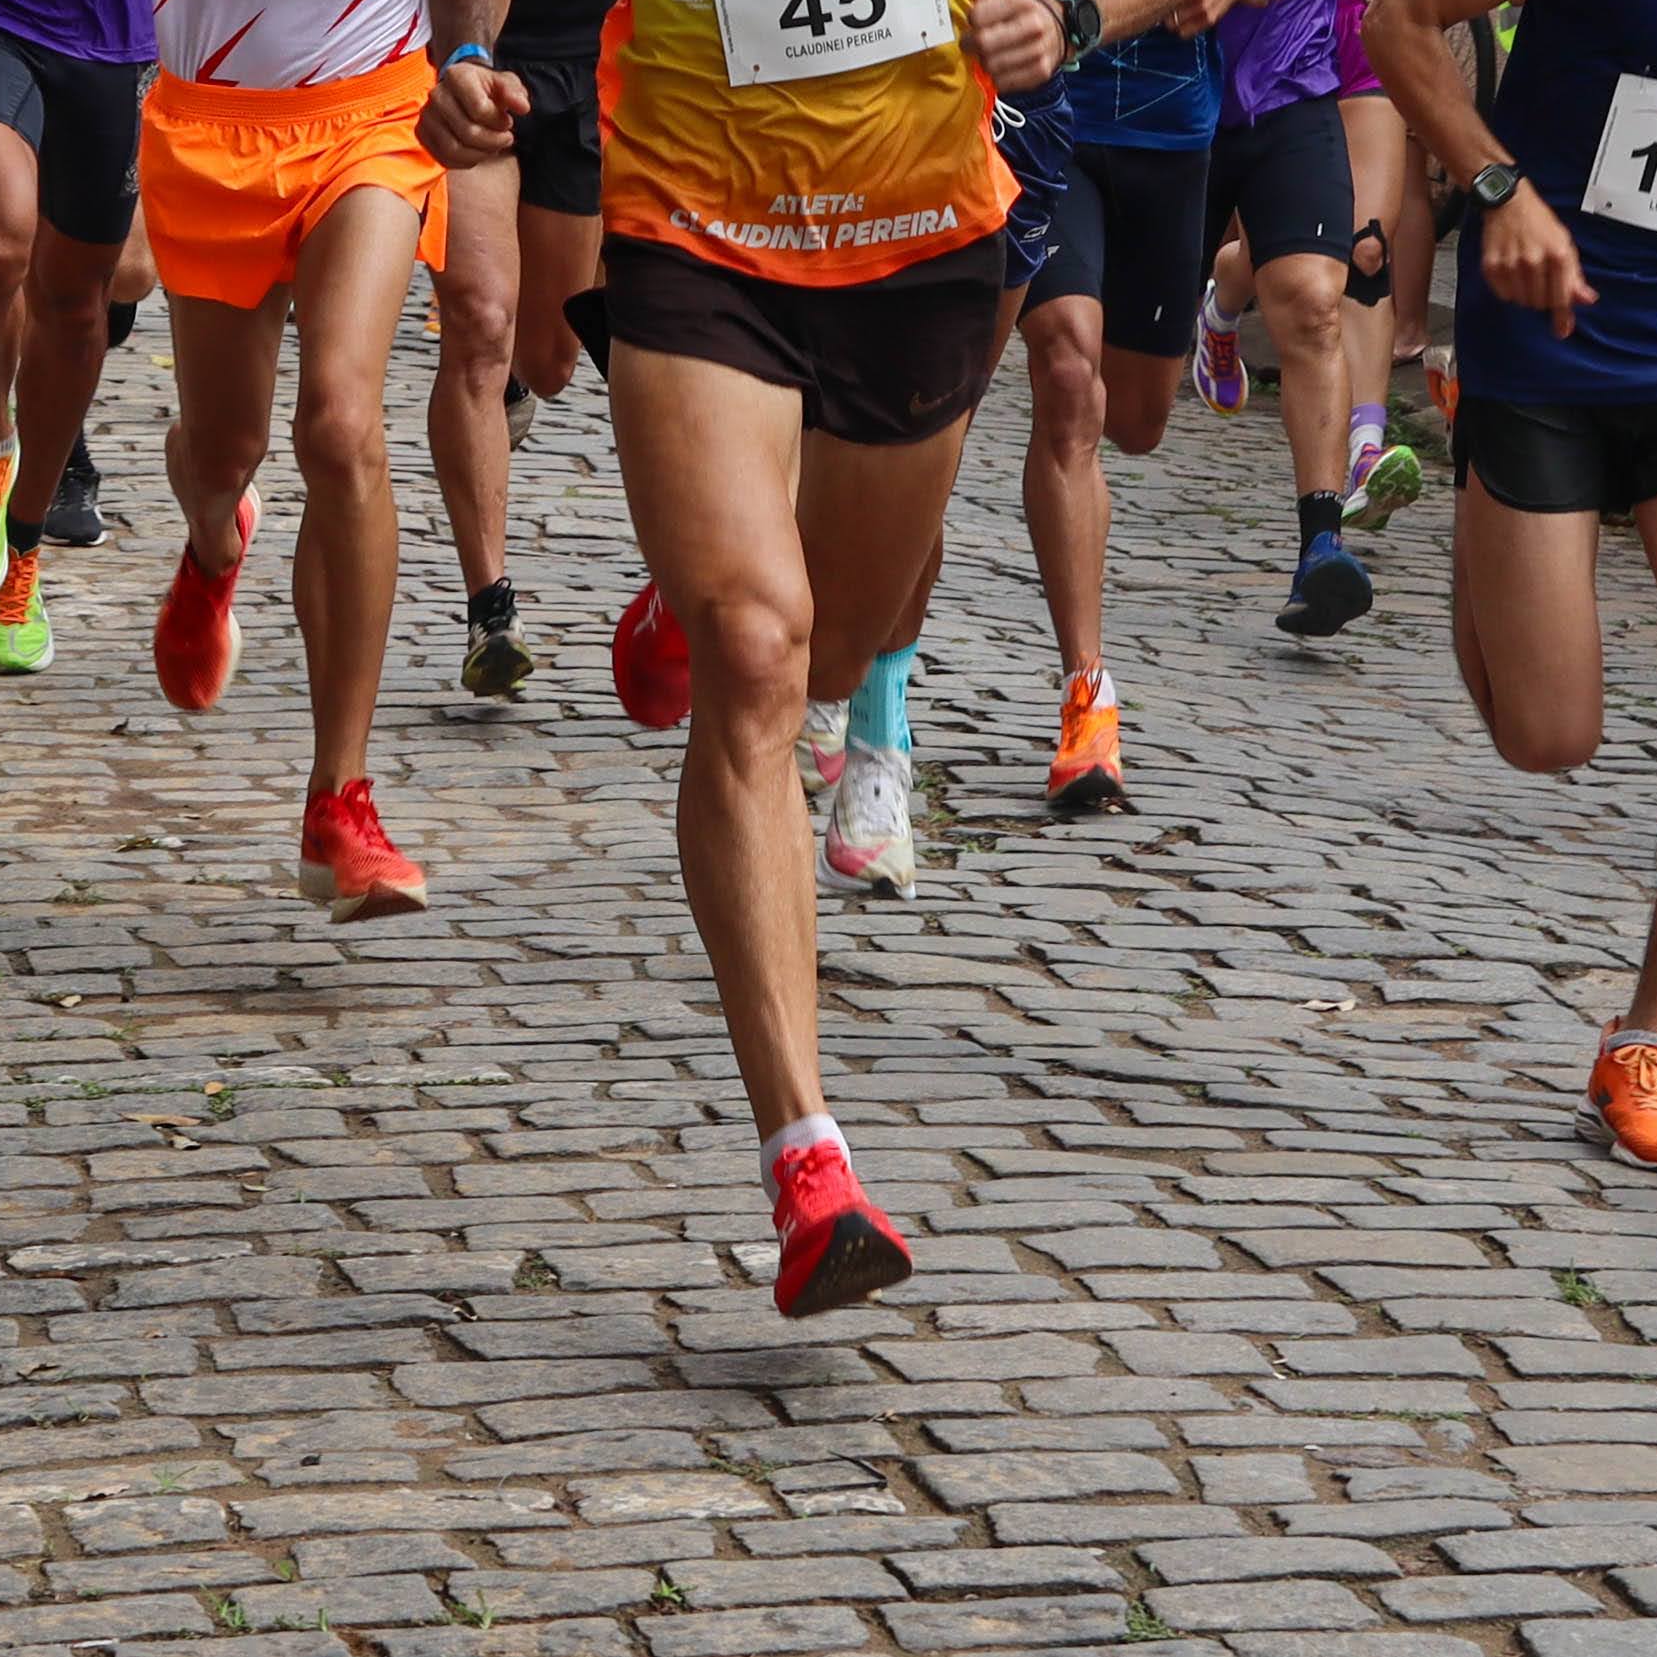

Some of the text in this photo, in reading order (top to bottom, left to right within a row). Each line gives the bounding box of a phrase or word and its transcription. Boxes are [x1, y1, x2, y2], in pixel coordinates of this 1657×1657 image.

[785, 27, 893, 59] CLAUDINEI PEREIRA
[768, 192, 865, 217] ATLETA:
[670, 204, 959, 251] CLAUDINEI PEREIRA
